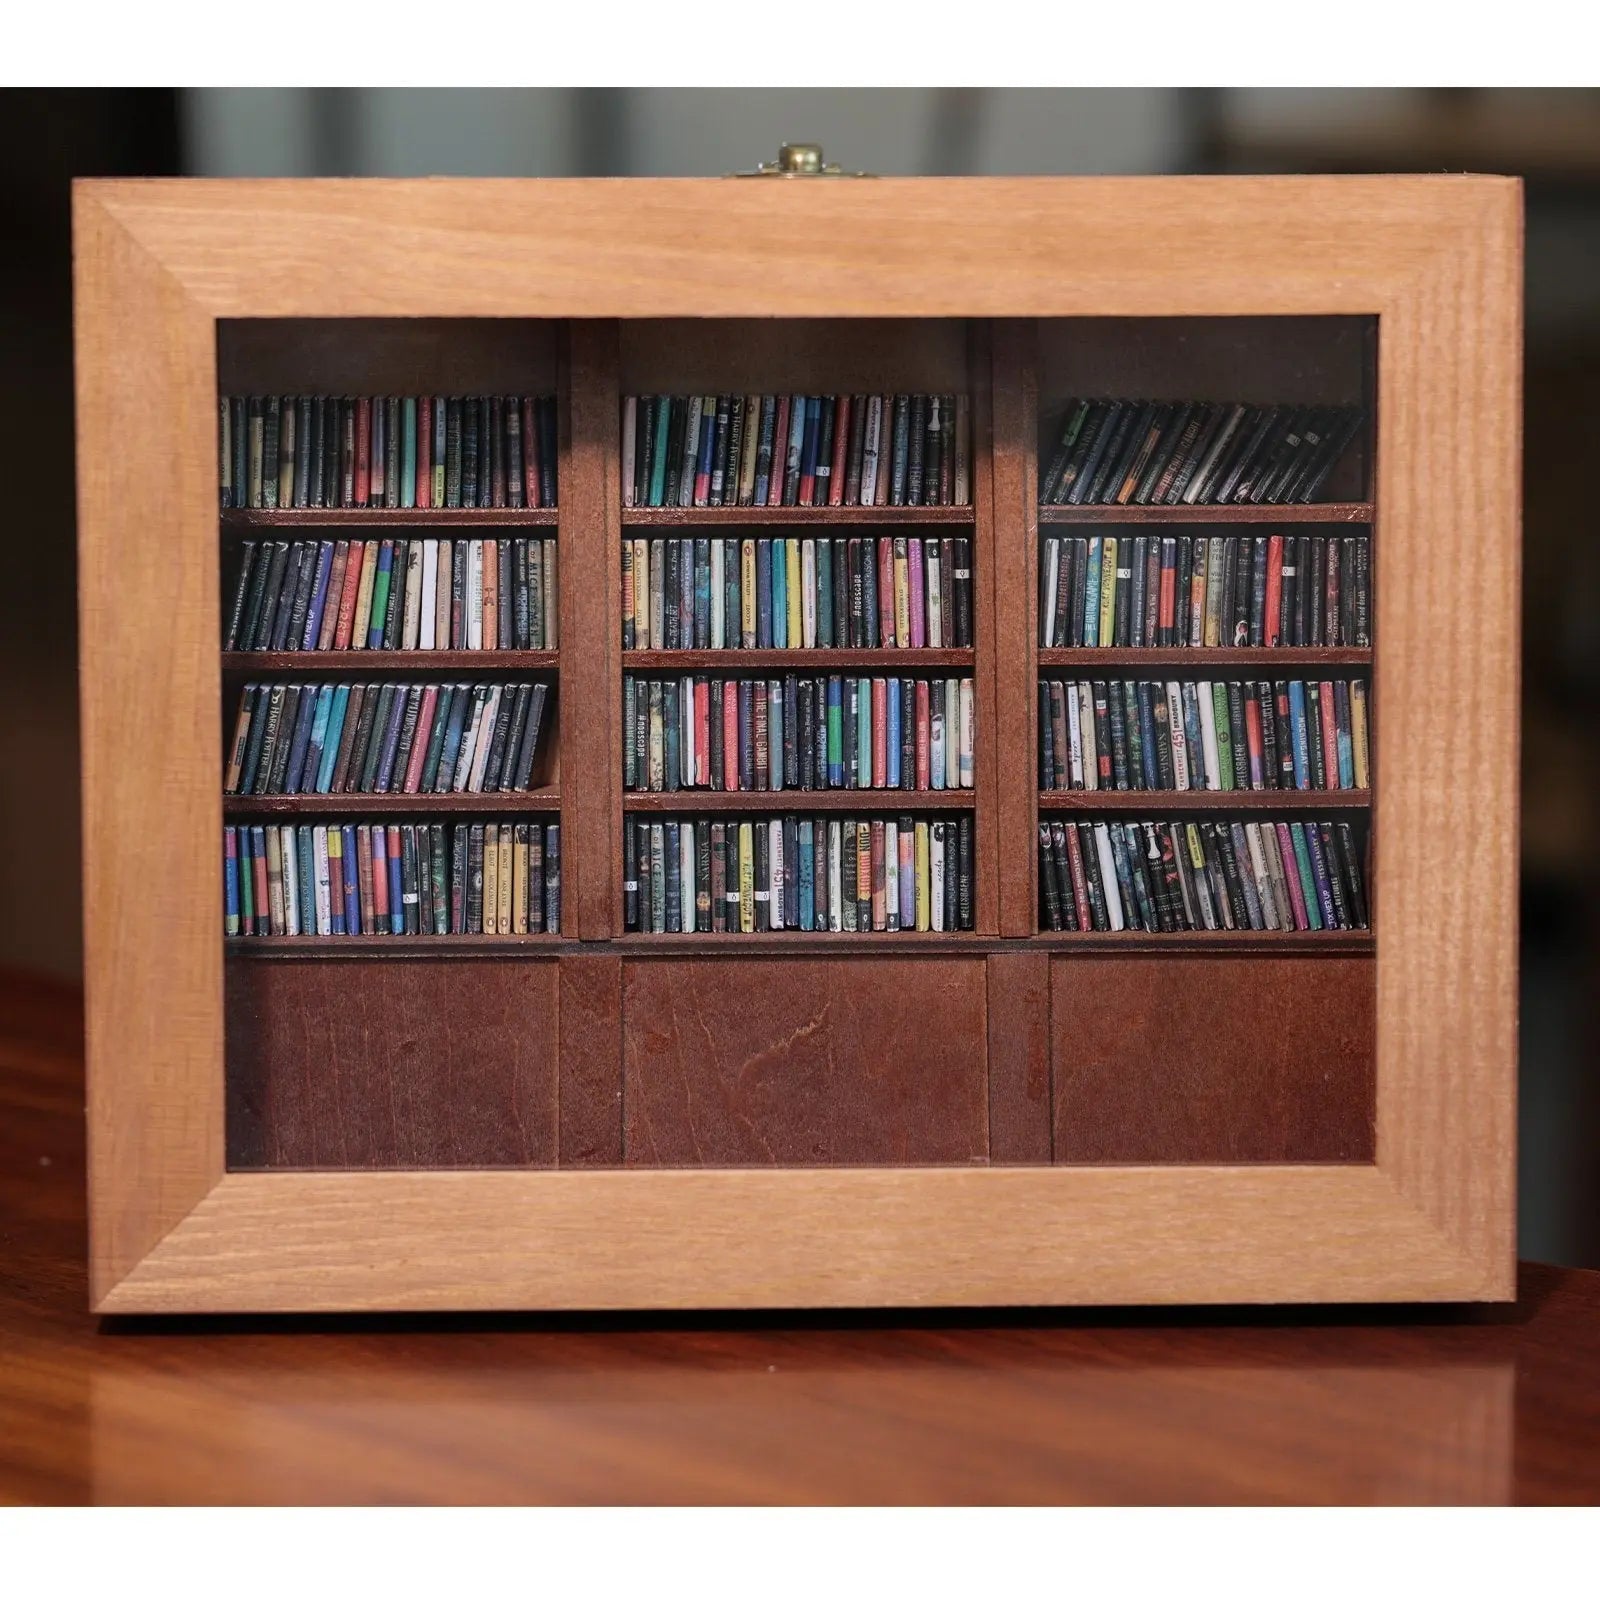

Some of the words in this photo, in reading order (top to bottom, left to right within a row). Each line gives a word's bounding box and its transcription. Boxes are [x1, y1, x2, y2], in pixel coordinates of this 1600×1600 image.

[756, 698, 767, 713] THE
[267, 706, 279, 734] HARRY
[756, 715, 767, 738] FINAL
[637, 715, 646, 757] #noescape
[1172, 729, 1184, 748] 451
[1298, 717, 1308, 765] MOCKINGJAY
[261, 736, 274, 766] POTTER
[756, 741, 767, 769] GAMBIT
[859, 832, 870, 852] DON
[652, 847, 661, 878] MICE
[1323, 890, 1330, 898] UP
